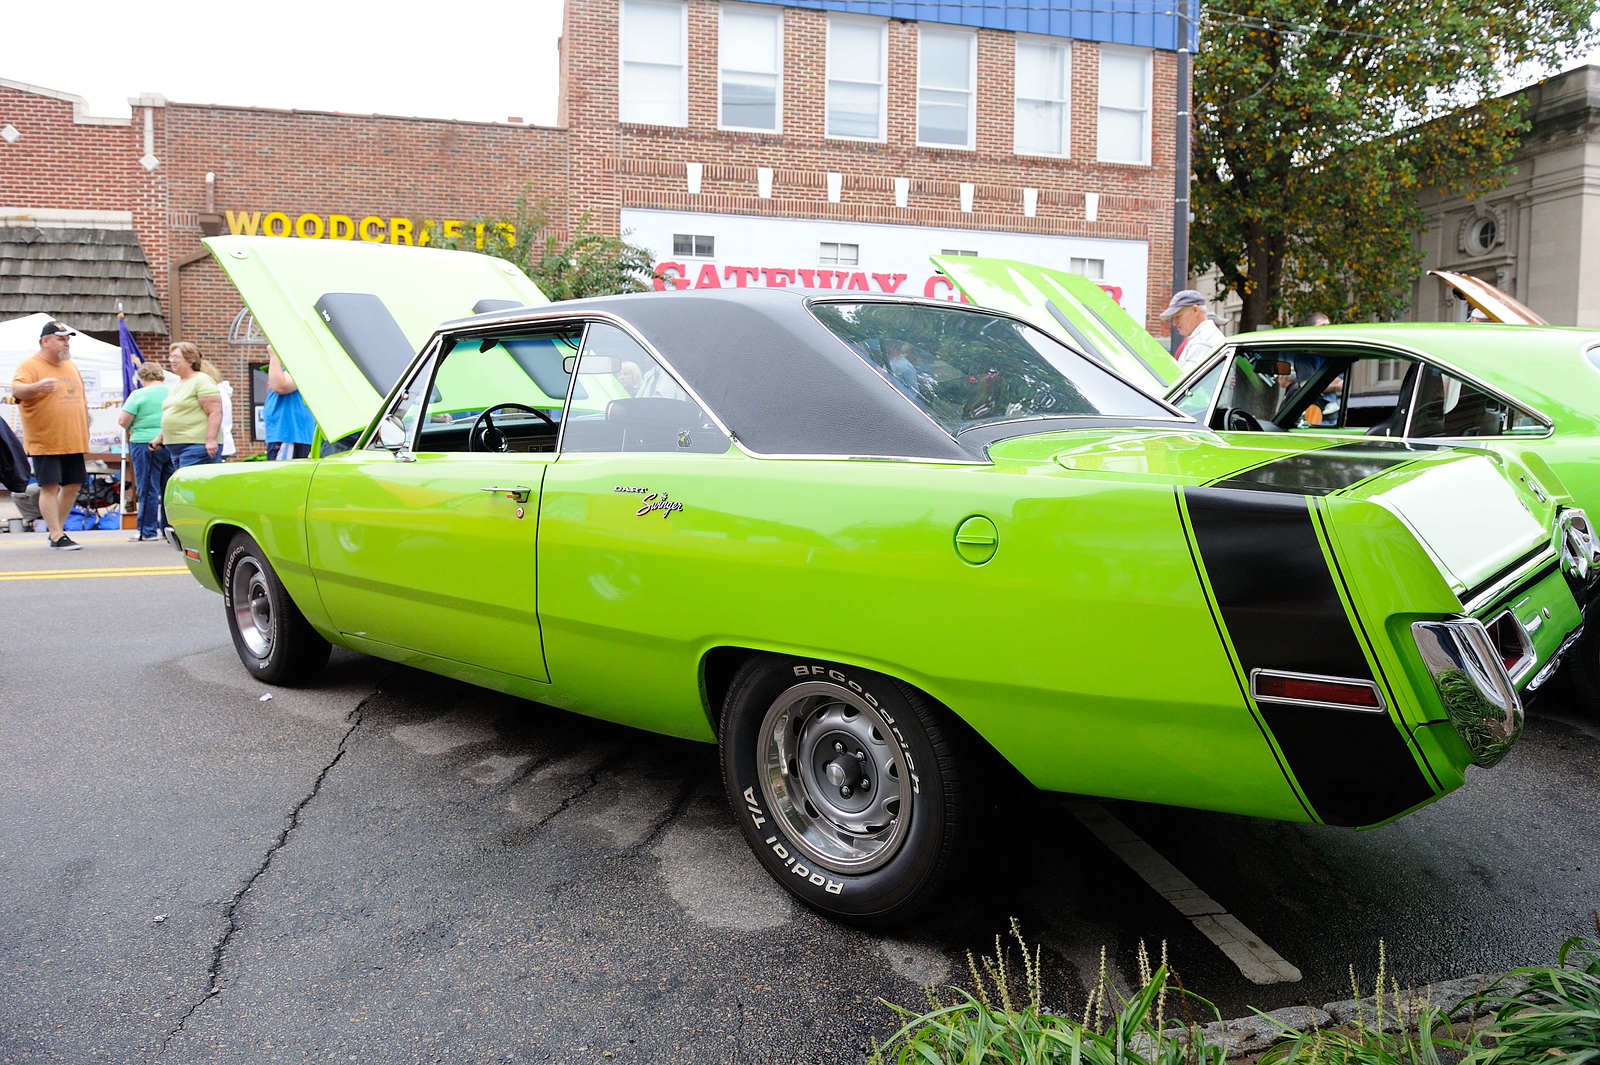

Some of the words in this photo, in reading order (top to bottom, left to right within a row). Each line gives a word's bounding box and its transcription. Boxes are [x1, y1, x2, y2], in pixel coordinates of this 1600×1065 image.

[614, 485, 648, 493] DART
[636, 492, 683, 518] Swinger
[793, 665, 921, 795] BFGoodrich
[743, 786, 767, 830] T/A
[765, 835, 844, 895] Radial
